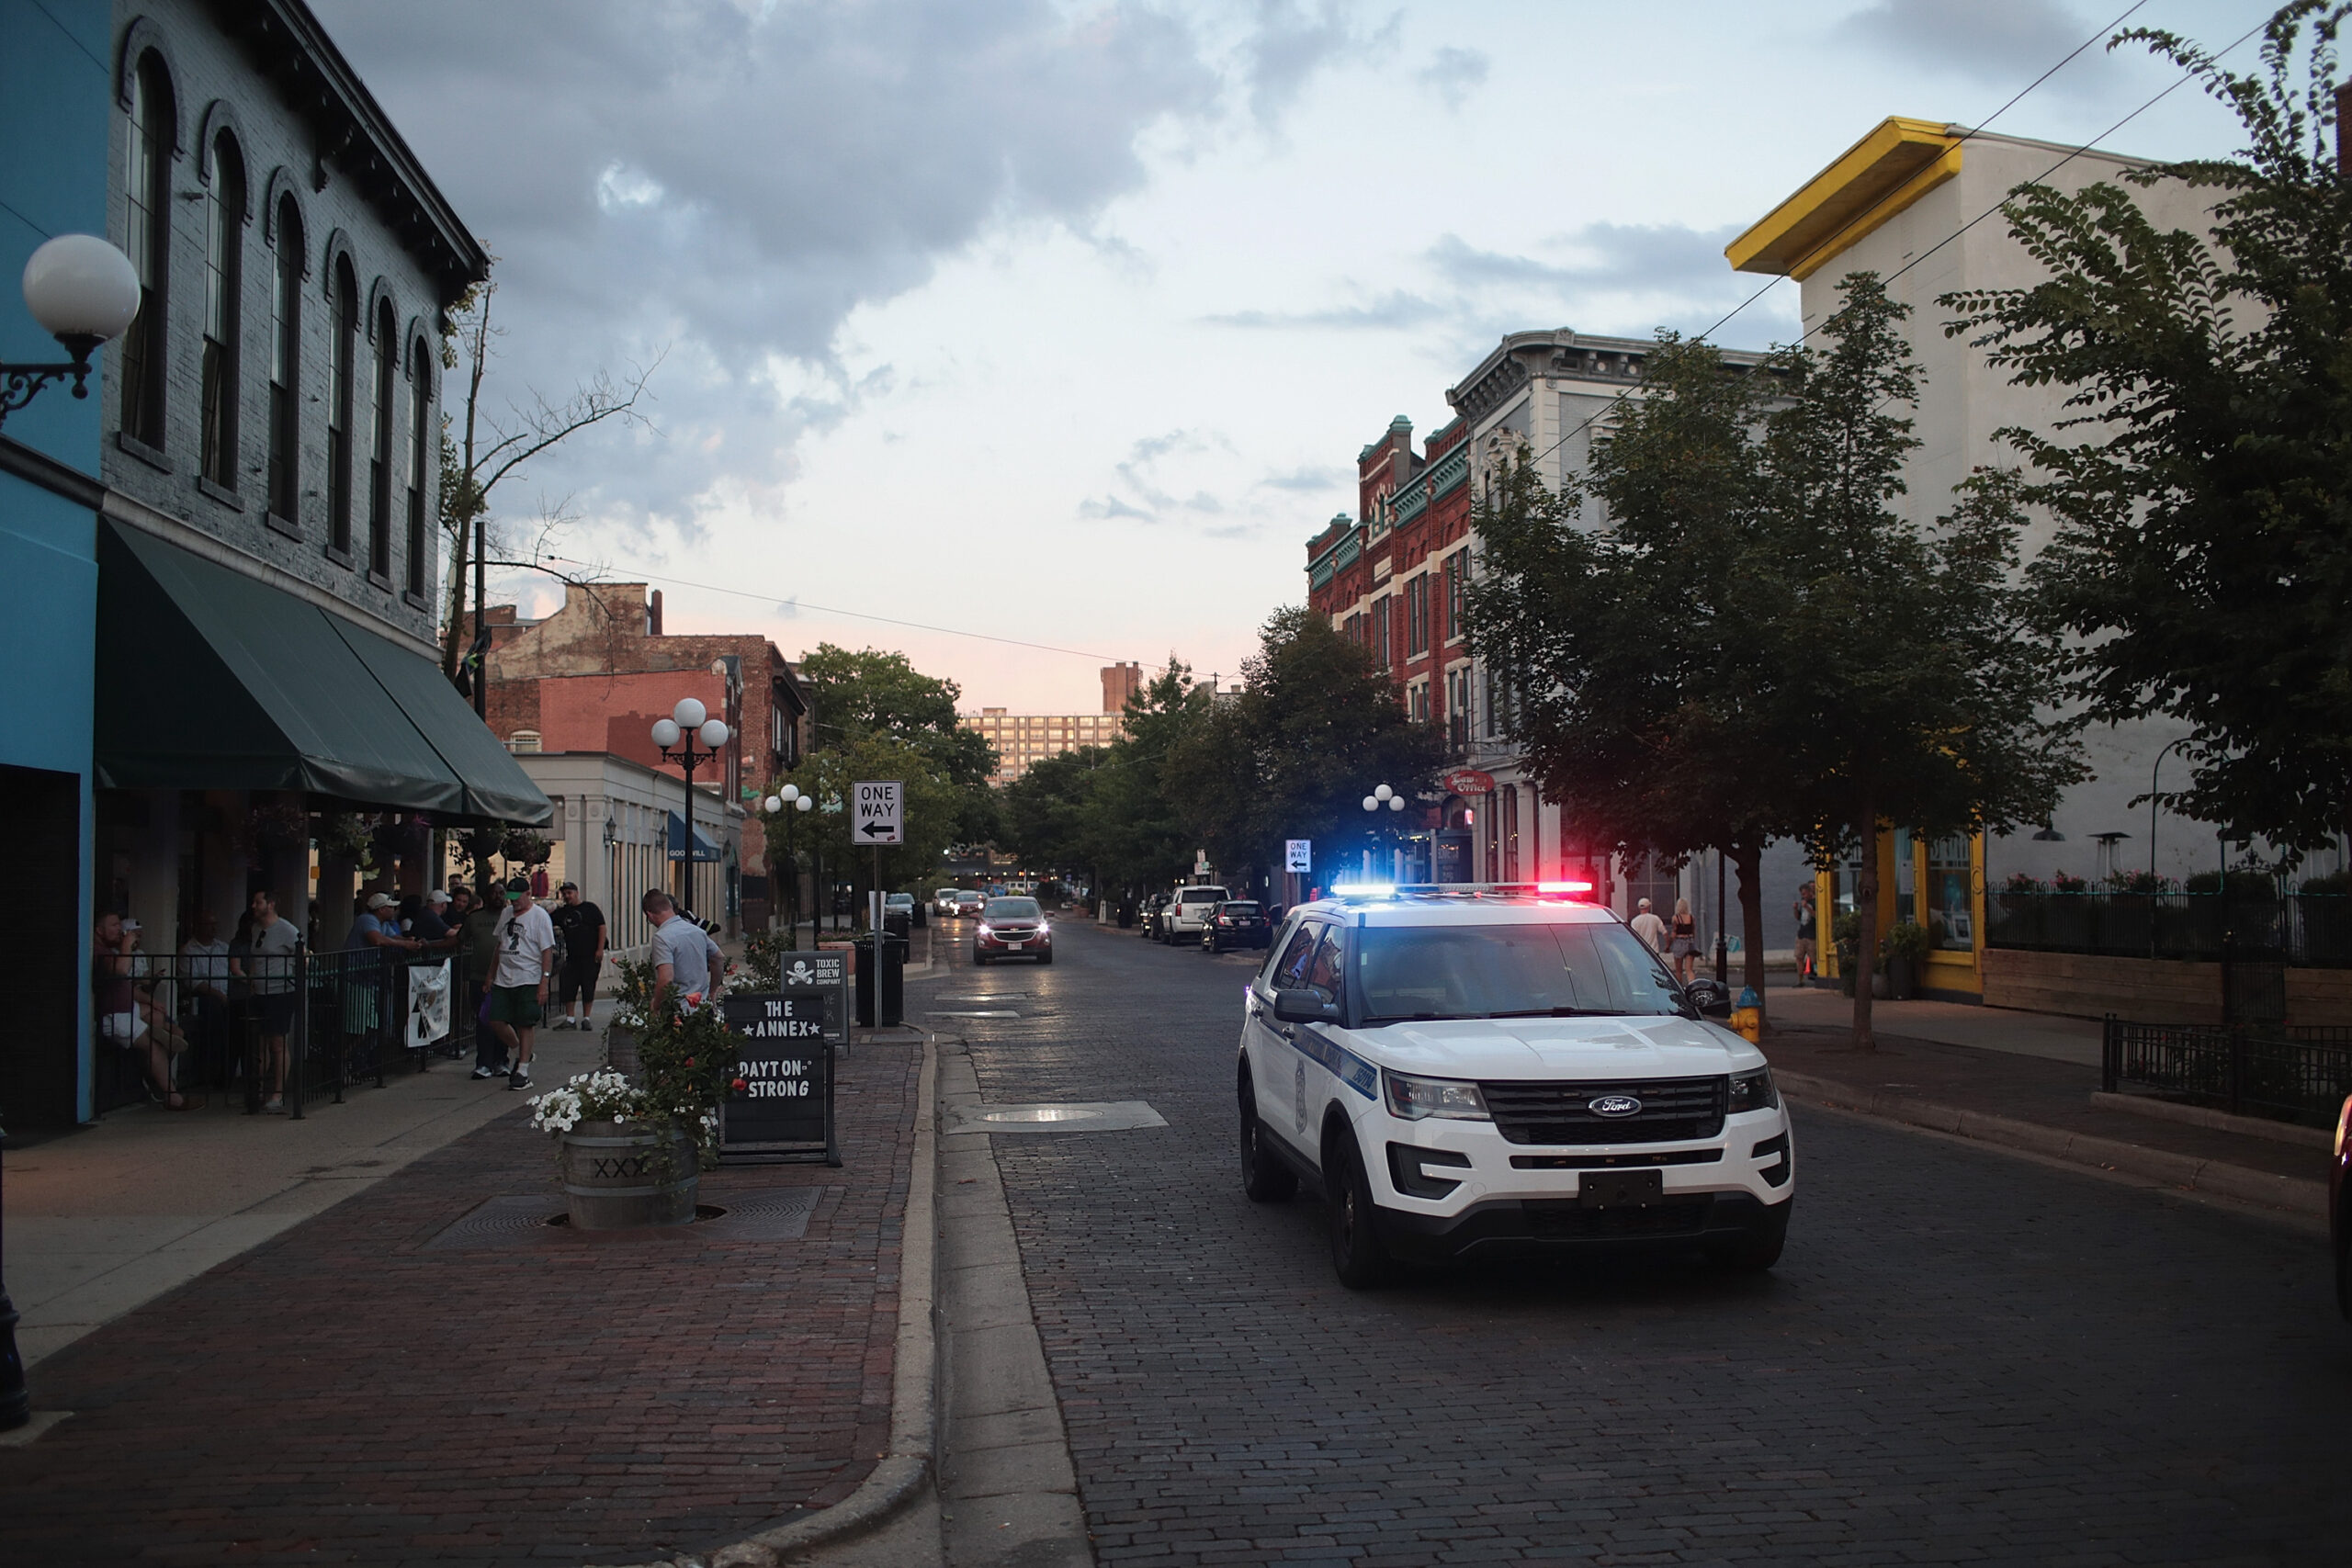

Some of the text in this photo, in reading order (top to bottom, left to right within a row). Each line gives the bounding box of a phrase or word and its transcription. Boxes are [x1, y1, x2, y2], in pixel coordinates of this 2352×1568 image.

[861, 786, 894, 800] ONE
[1457, 783, 1487, 792] Office
[860, 803, 895, 817] WAY
[1290, 842, 1306, 851] ONE
[1290, 851, 1307, 859] WAY
[816, 958, 840, 968] TOXIC
[816, 968, 840, 978] BREW
[764, 1000, 793, 1017] THE
[756, 1021, 808, 1037] ANNEX
[739, 1060, 801, 1077] DAYTON
[748, 1080, 809, 1098] STRONG
[1602, 1099, 1631, 1111] Ford
[594, 1157, 648, 1178] XXX
